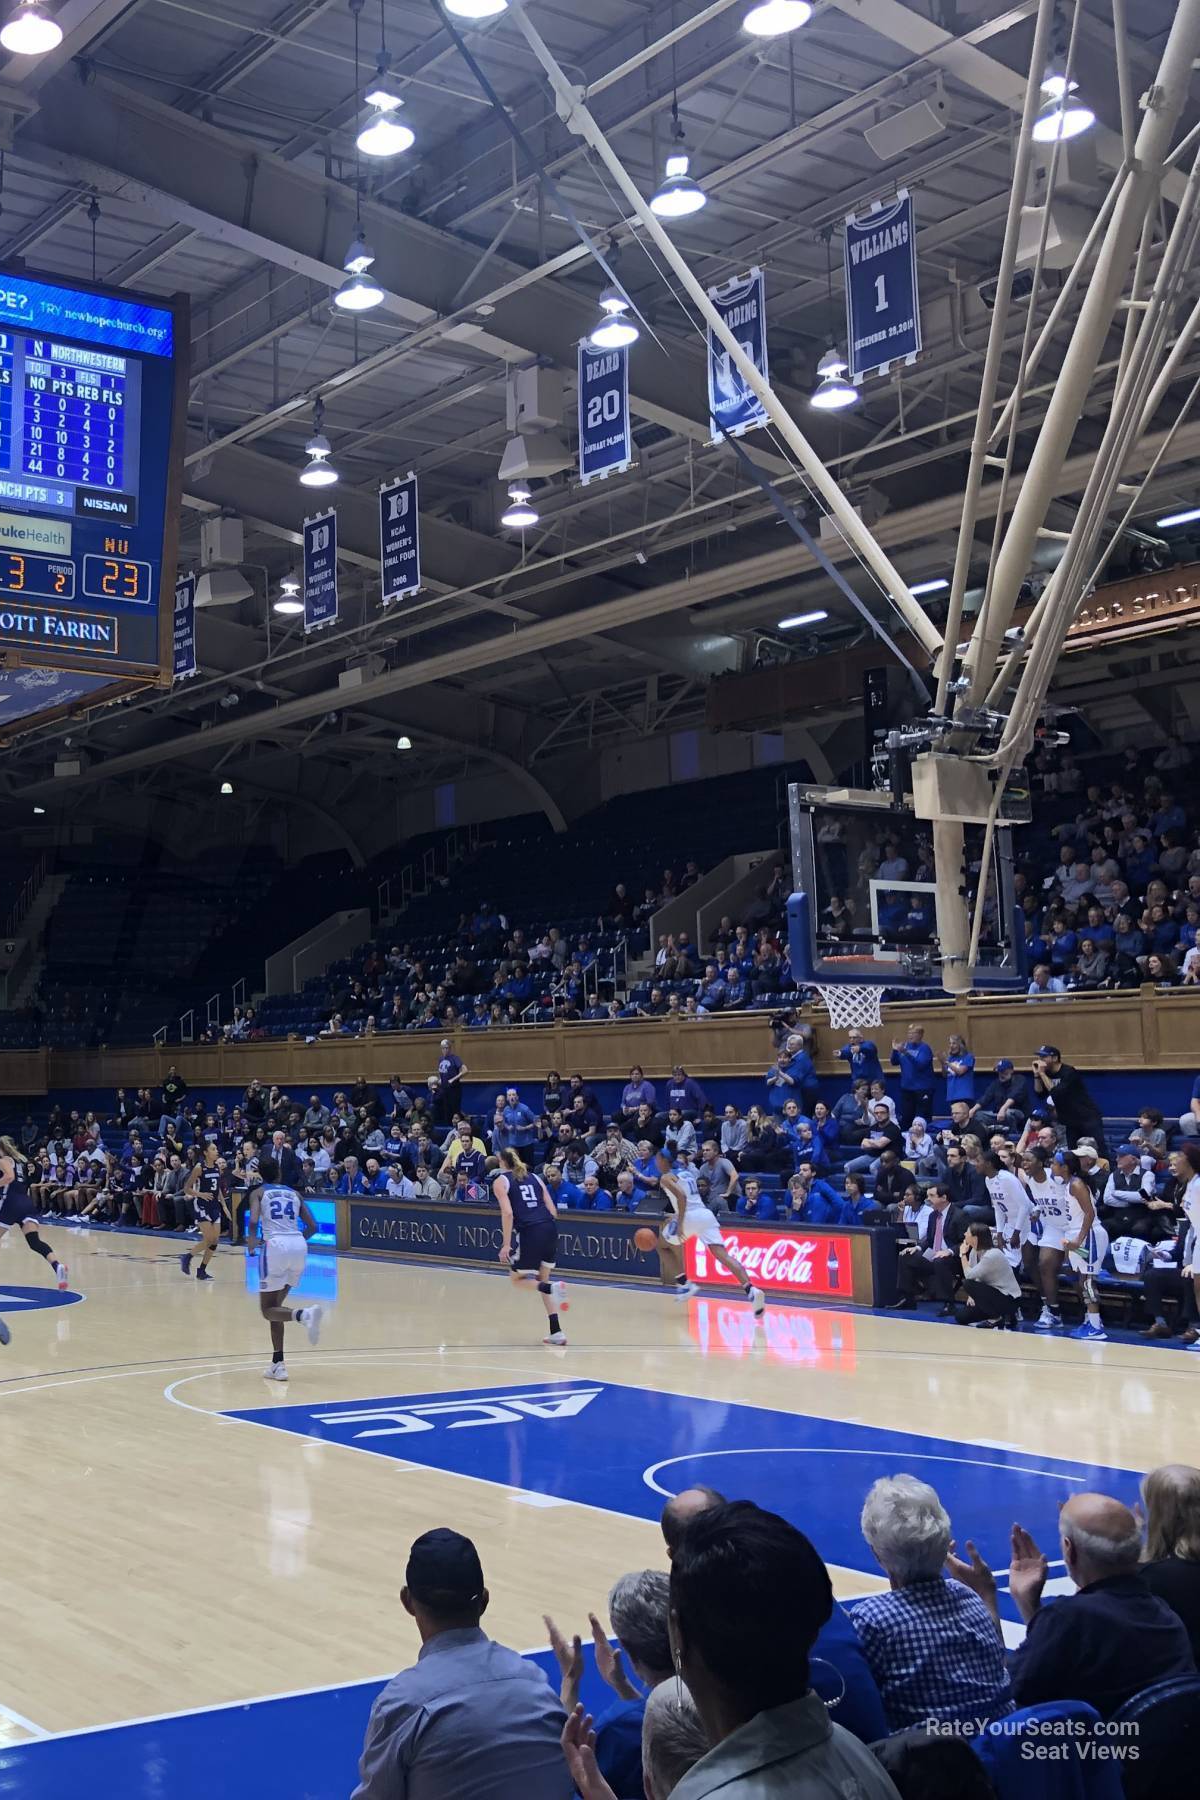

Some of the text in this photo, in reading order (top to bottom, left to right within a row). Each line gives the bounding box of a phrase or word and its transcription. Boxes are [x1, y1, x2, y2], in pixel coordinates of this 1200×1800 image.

[850, 220, 909, 266] WILLIAMS
[874, 274, 889, 313] 1
[723, 298, 757, 330] ARDING
[854, 330, 887, 351] DECEMBER
[50, 344, 126, 371] NORTHWESTERN
[586, 351, 620, 382] BEARD
[30, 376, 123, 406] NO PTS REB FLS
[60, 368, 66, 378] 3
[110, 378, 114, 388] 1
[33, 394, 116, 420] 2 0 2 0
[587, 389, 620, 428] 20
[33, 410, 114, 436] 3 2 4 1
[30, 426, 114, 452] 10 10 3 2
[30, 442, 114, 469] 21 8 4 0
[28, 459, 114, 485] 44 0 2 0
[25, 485, 48, 502] PTS
[56, 491, 64, 504] 3
[83, 496, 128, 514] NISSAN
[390, 524, 406, 538] NCAA
[104, 537, 129, 555] NU
[384, 549, 416, 569] FINAL FOUR
[47, 564, 74, 576] PERIOD
[102, 561, 138, 596] 23
[54, 574, 66, 593] 2
[44, 616, 111, 642] FARRIN
[210, 1178, 217, 1191] 3
[519, 1184, 538, 1201] 21
[270, 1200, 295, 1220] 24
[359, 1217, 644, 1263] CAMERON INDO TADIUM
[715, 1236, 818, 1284] Coca-Cola
